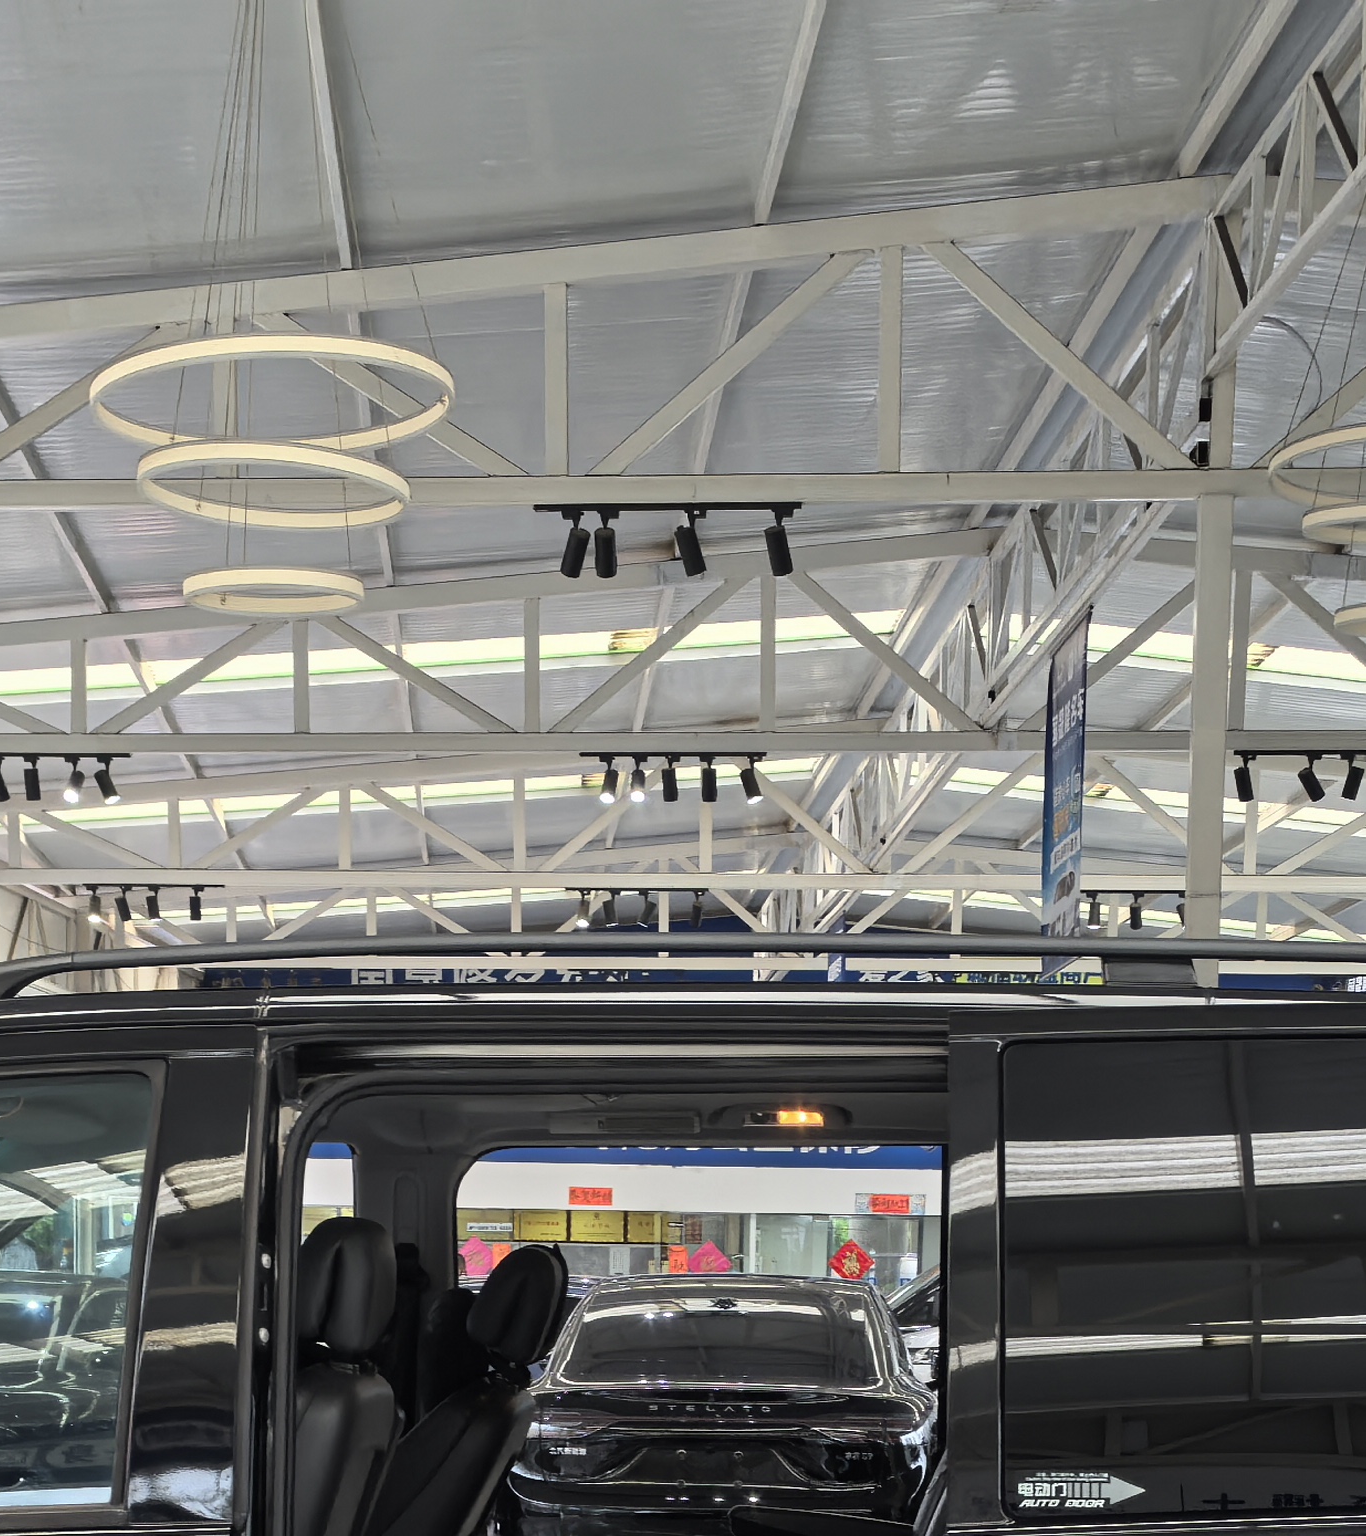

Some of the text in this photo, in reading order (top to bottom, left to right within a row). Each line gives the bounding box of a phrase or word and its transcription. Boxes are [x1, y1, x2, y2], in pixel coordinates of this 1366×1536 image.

[648, 1404, 771, 1413] STELATO
[1017, 1482, 1067, 1497] 电动门
[1018, 1499, 1105, 1508] AUTO DOOR
